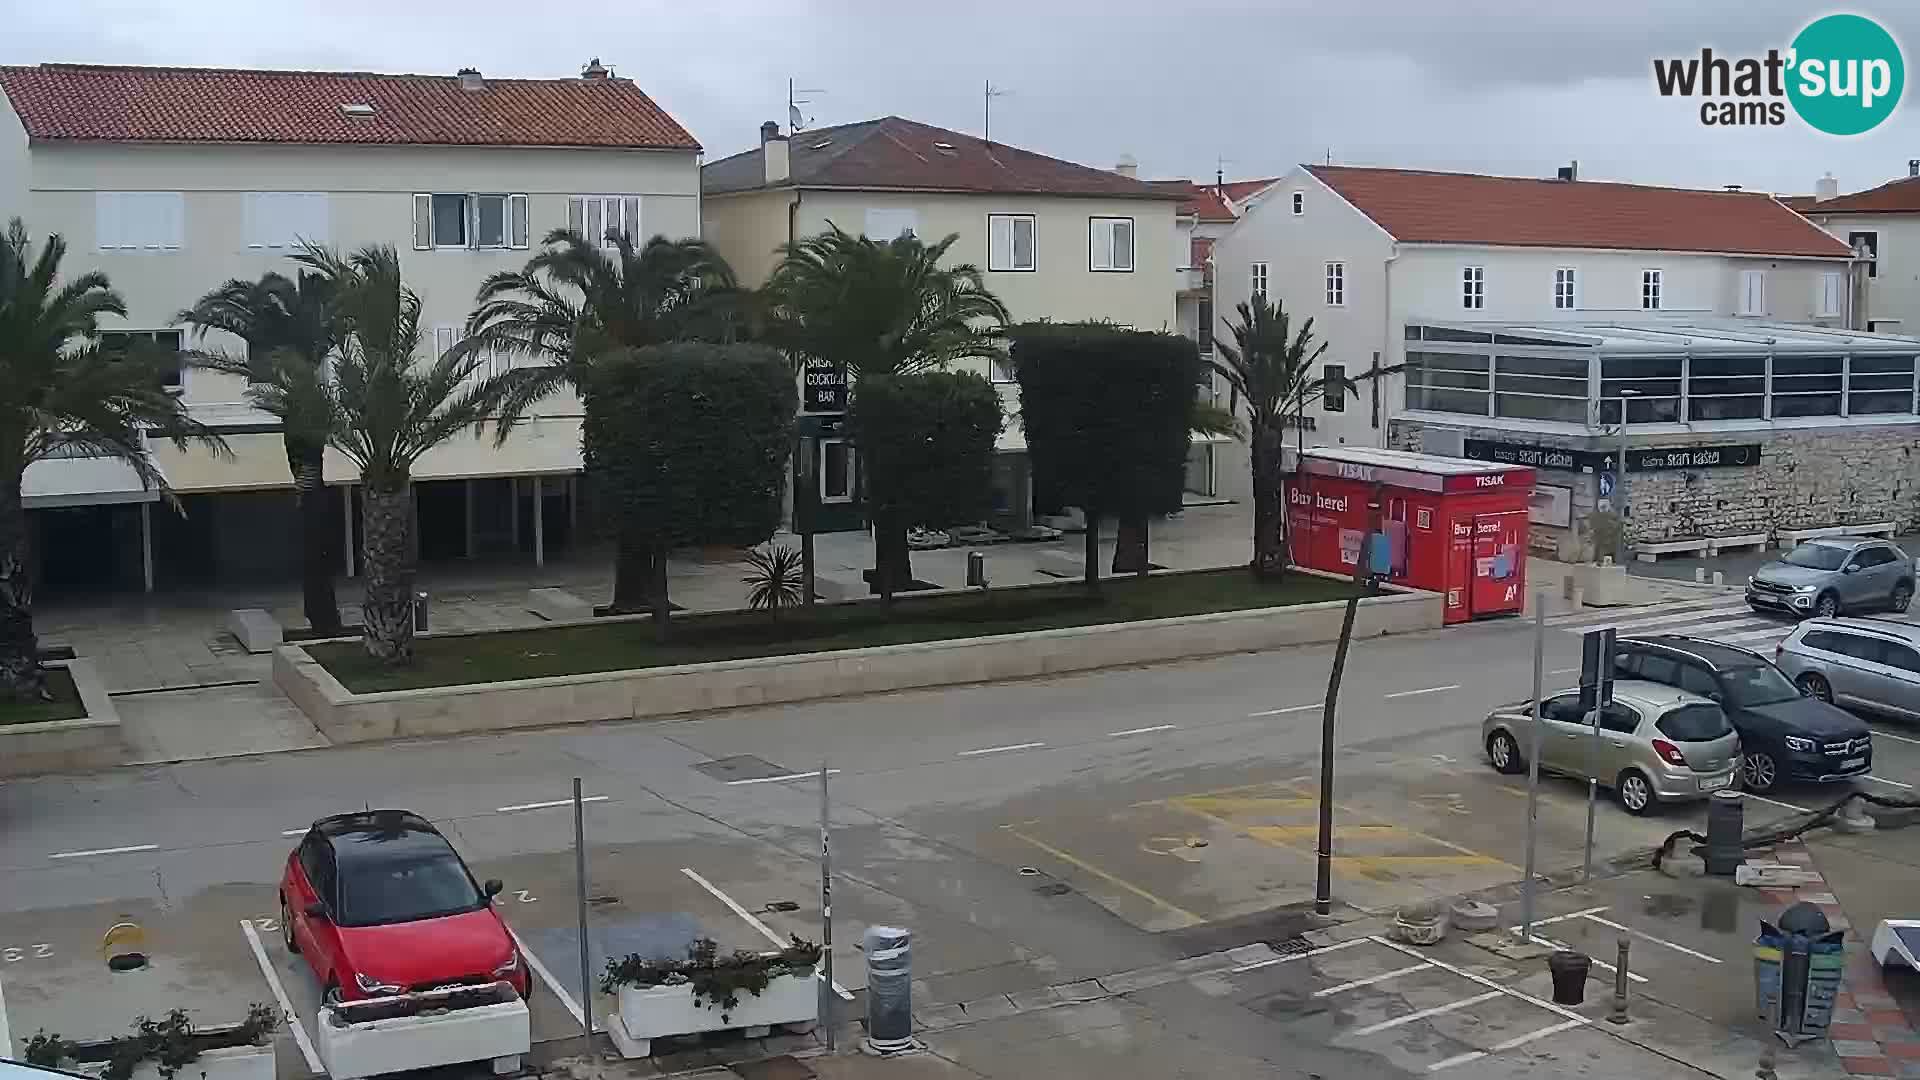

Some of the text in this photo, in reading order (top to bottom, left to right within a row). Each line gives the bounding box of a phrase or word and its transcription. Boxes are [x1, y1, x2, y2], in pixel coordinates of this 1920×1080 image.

[818, 390, 835, 402] BAR
[1667, 452, 1690, 466] stari
[1336, 463, 1373, 480] TISAK
[1475, 475, 1505, 487] TISAK
[1291, 488, 1348, 512] Buy here!
[1454, 520, 1501, 536] Buy here!
